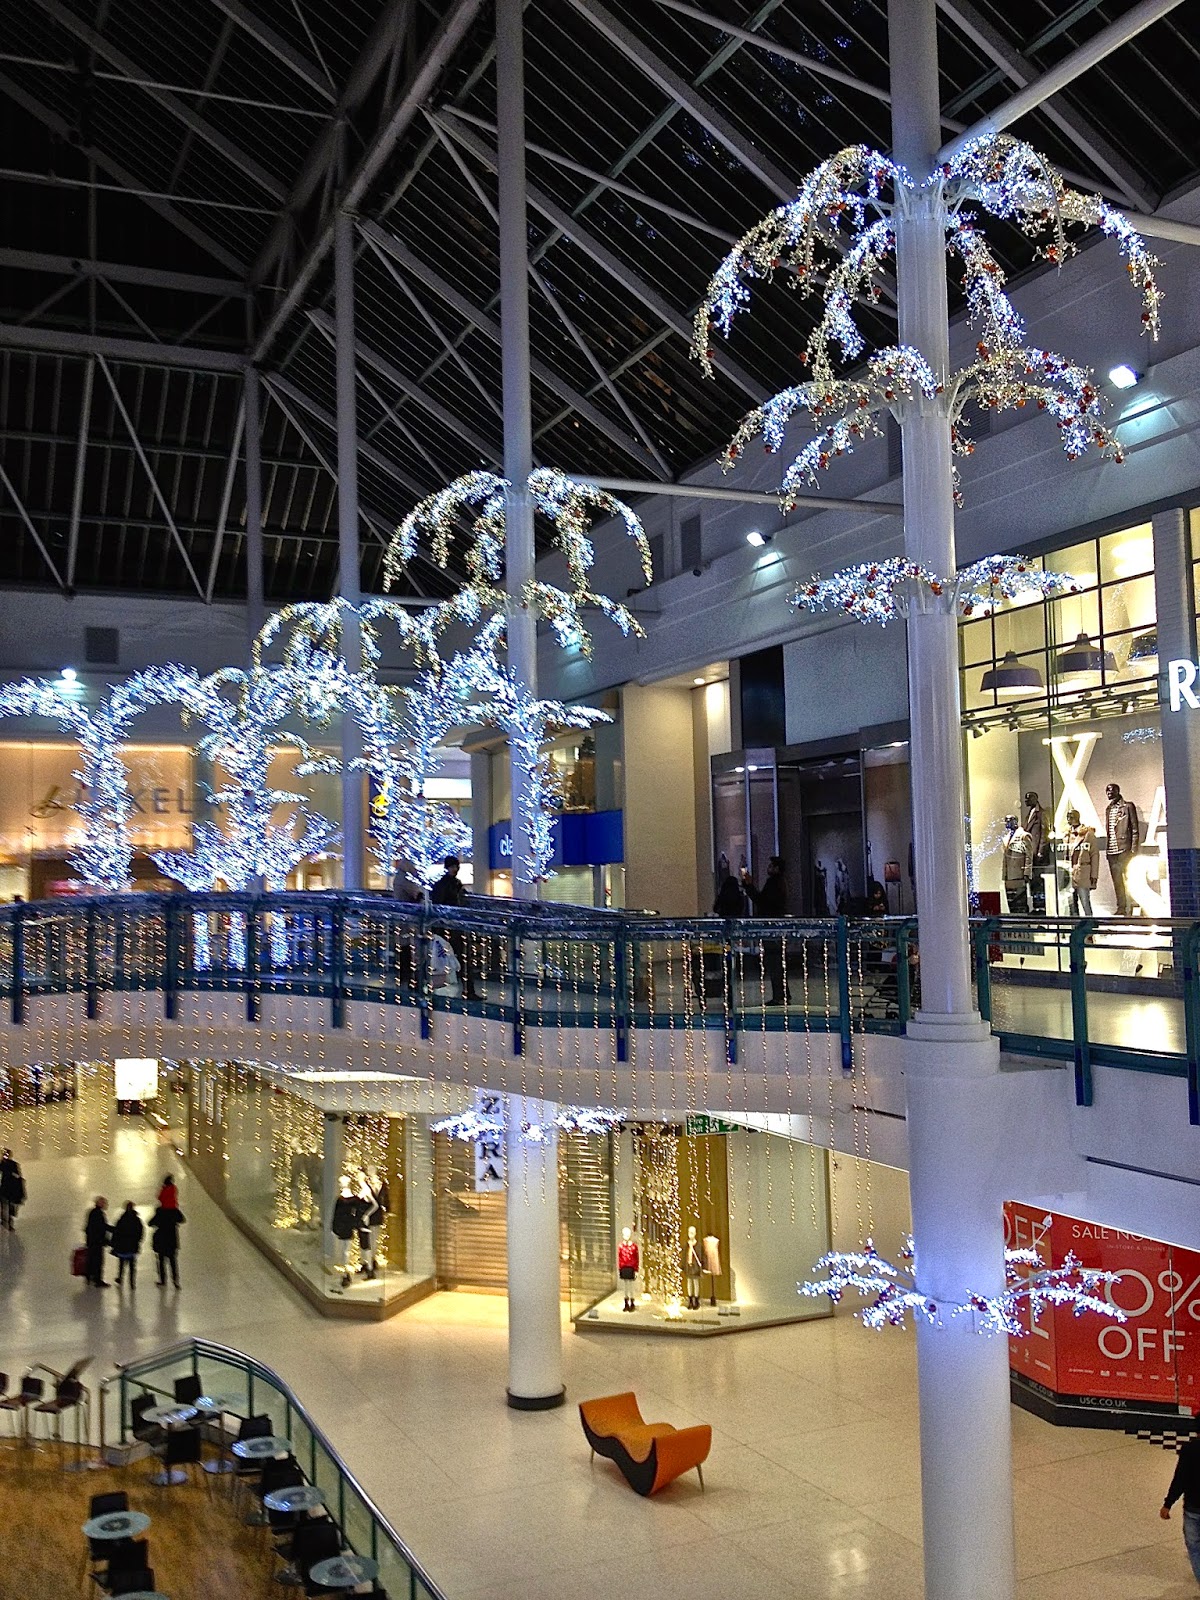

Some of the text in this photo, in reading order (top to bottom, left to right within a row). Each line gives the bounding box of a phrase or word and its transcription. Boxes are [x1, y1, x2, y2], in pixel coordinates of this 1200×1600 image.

[478, 1097, 503, 1181] ZRA
[1072, 1225, 1109, 1240] SALE
[1073, 1267, 1200, 1320] 0%
[1098, 1325, 1186, 1363] OFF
[1080, 1397, 1127, 1408] USC.CO.UK
